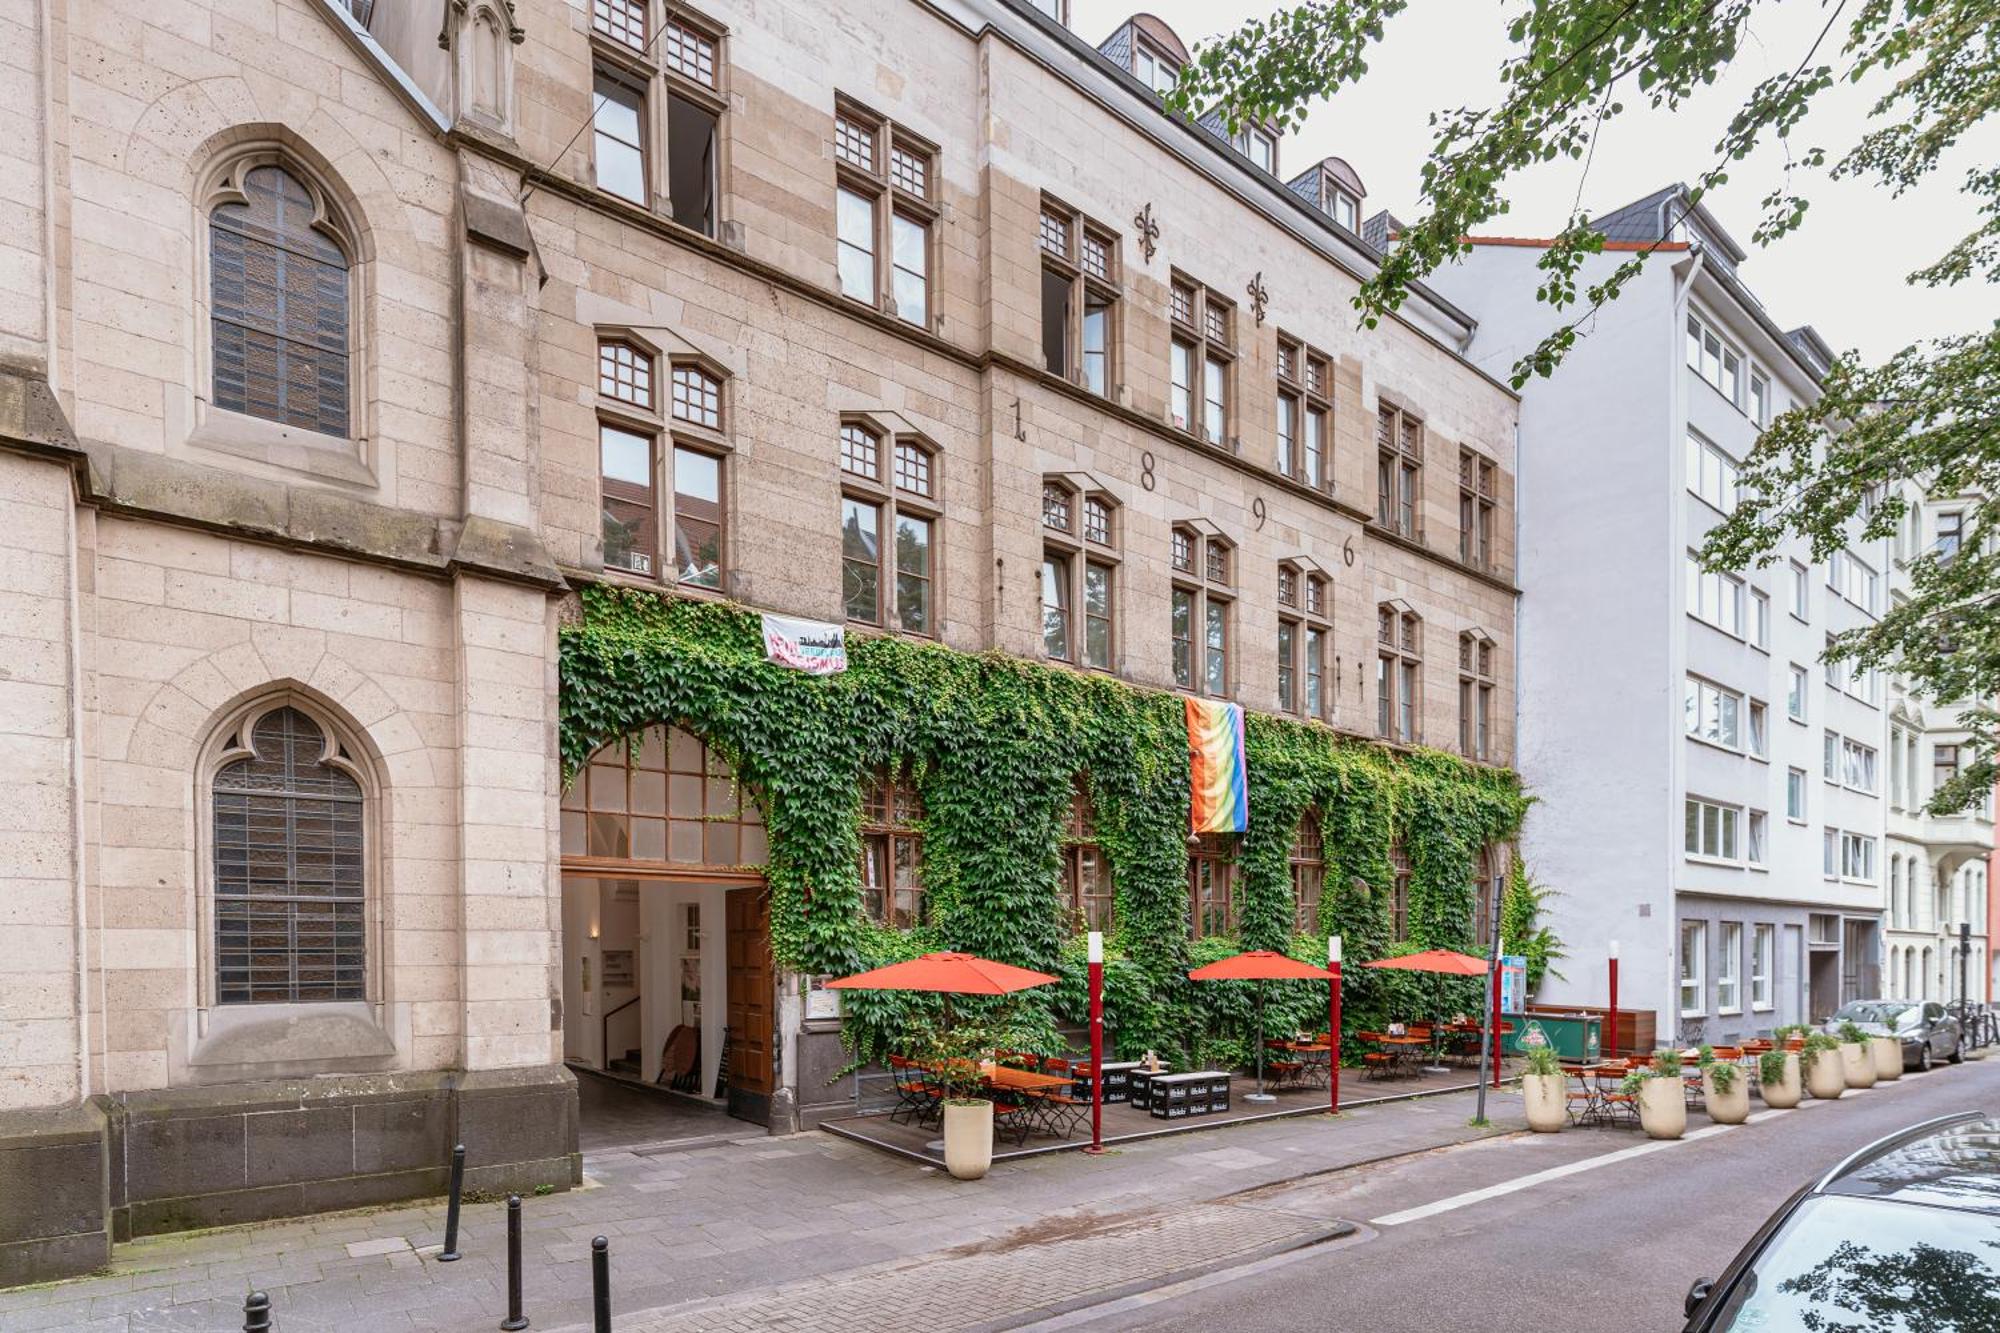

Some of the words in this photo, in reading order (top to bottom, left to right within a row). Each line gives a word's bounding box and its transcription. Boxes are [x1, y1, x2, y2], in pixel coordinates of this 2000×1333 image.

[1009, 397, 1026, 443] 1
[1141, 451, 1155, 492] 8
[1253, 497, 1266, 532] 9
[1343, 535, 1354, 567] 6
